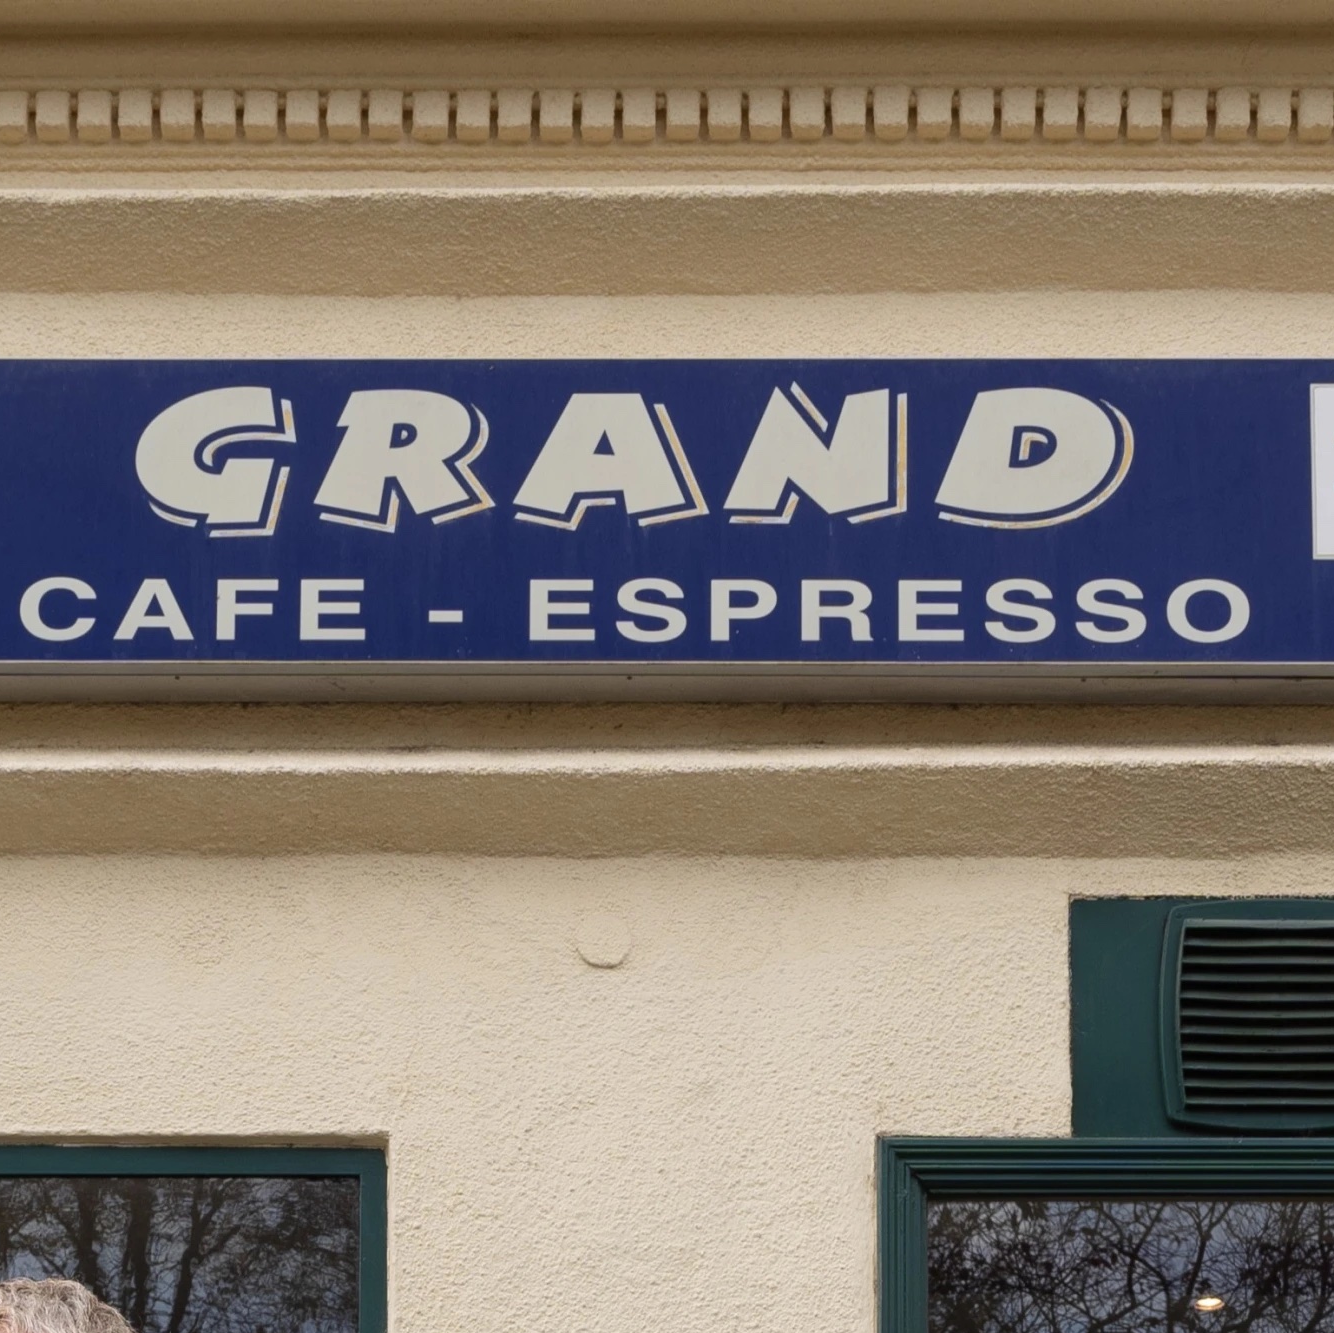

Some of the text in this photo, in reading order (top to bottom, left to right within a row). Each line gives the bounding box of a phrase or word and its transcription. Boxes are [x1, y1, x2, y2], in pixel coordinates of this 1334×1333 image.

[134, 382, 1135, 538] GRAND
[19, 576, 366, 641] CAFE
[529, 577, 1250, 644] ESPRESSO
